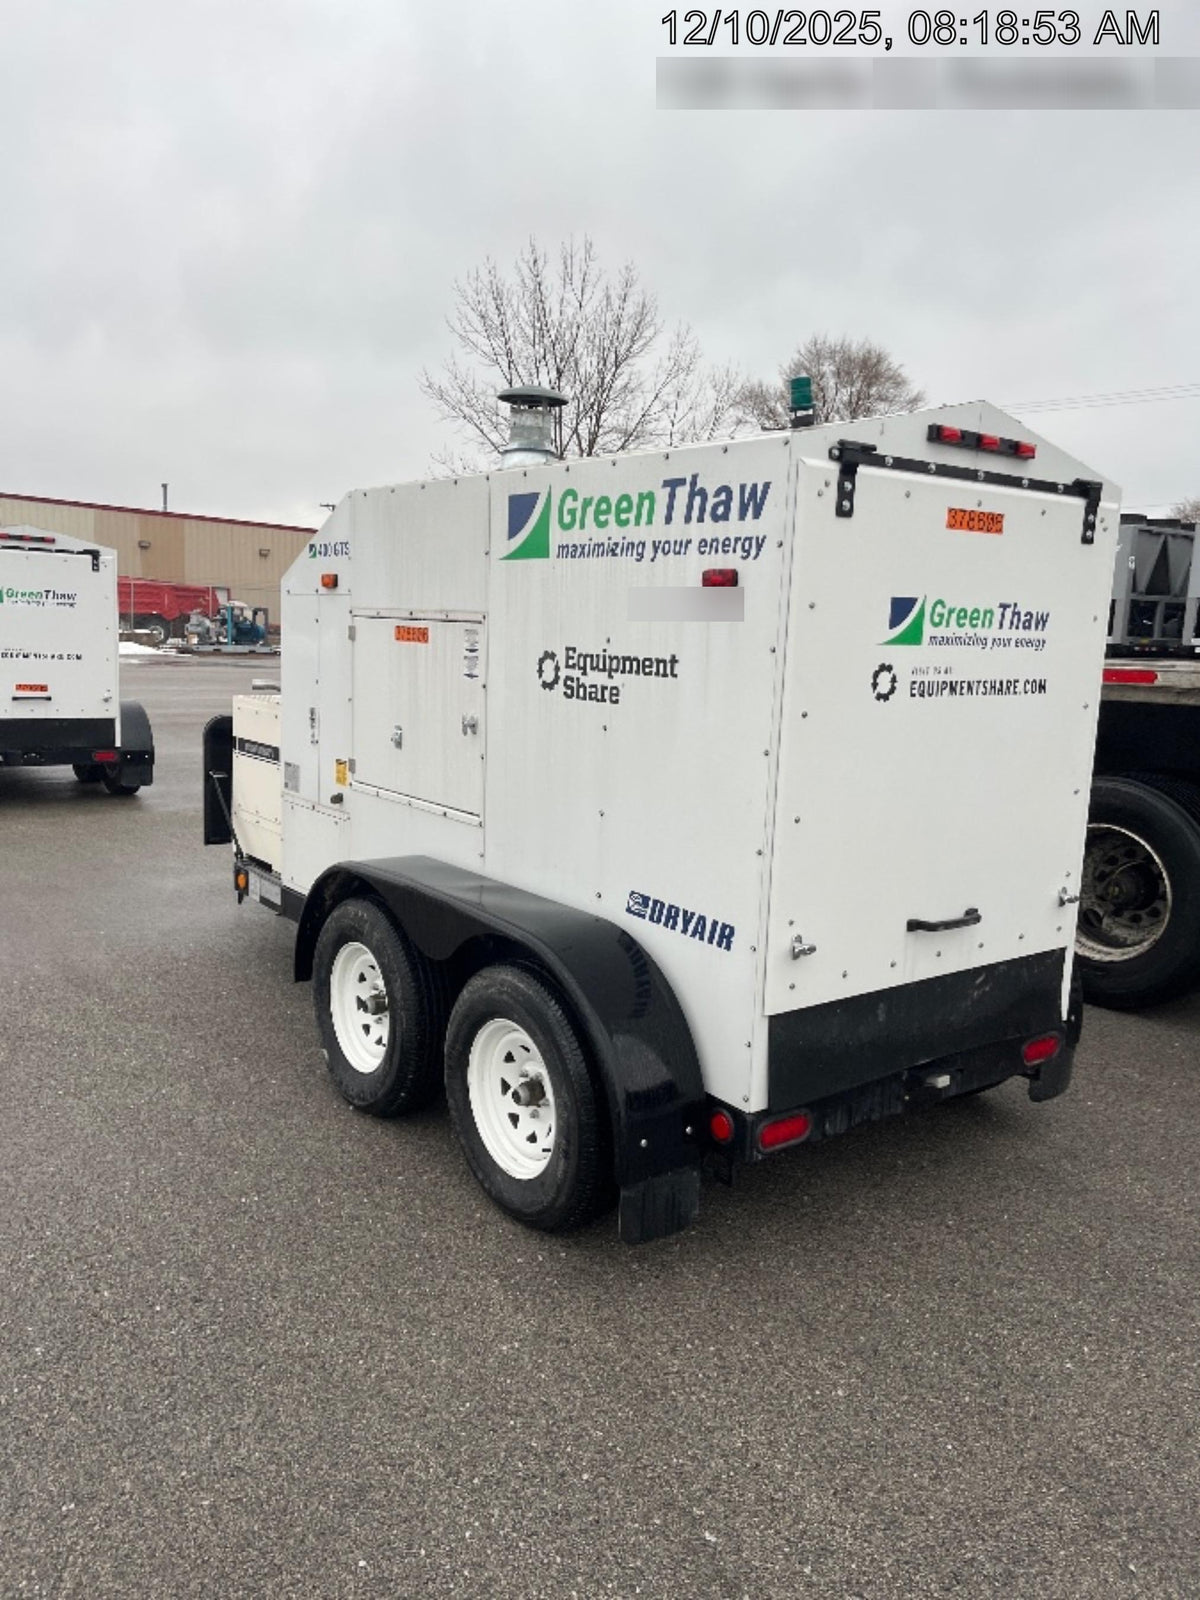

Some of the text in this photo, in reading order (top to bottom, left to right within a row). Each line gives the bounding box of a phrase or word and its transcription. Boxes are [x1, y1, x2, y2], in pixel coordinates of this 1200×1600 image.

[556, 535, 767, 562] maximizing your energy
[928, 632, 1047, 651] maximizing your energy
[564, 646, 679, 679] Equipment
[563, 675, 620, 704] Share
[909, 678, 1048, 698] EQUIPMENTSHARE.COM
[648, 898, 736, 951] DRYAIR
